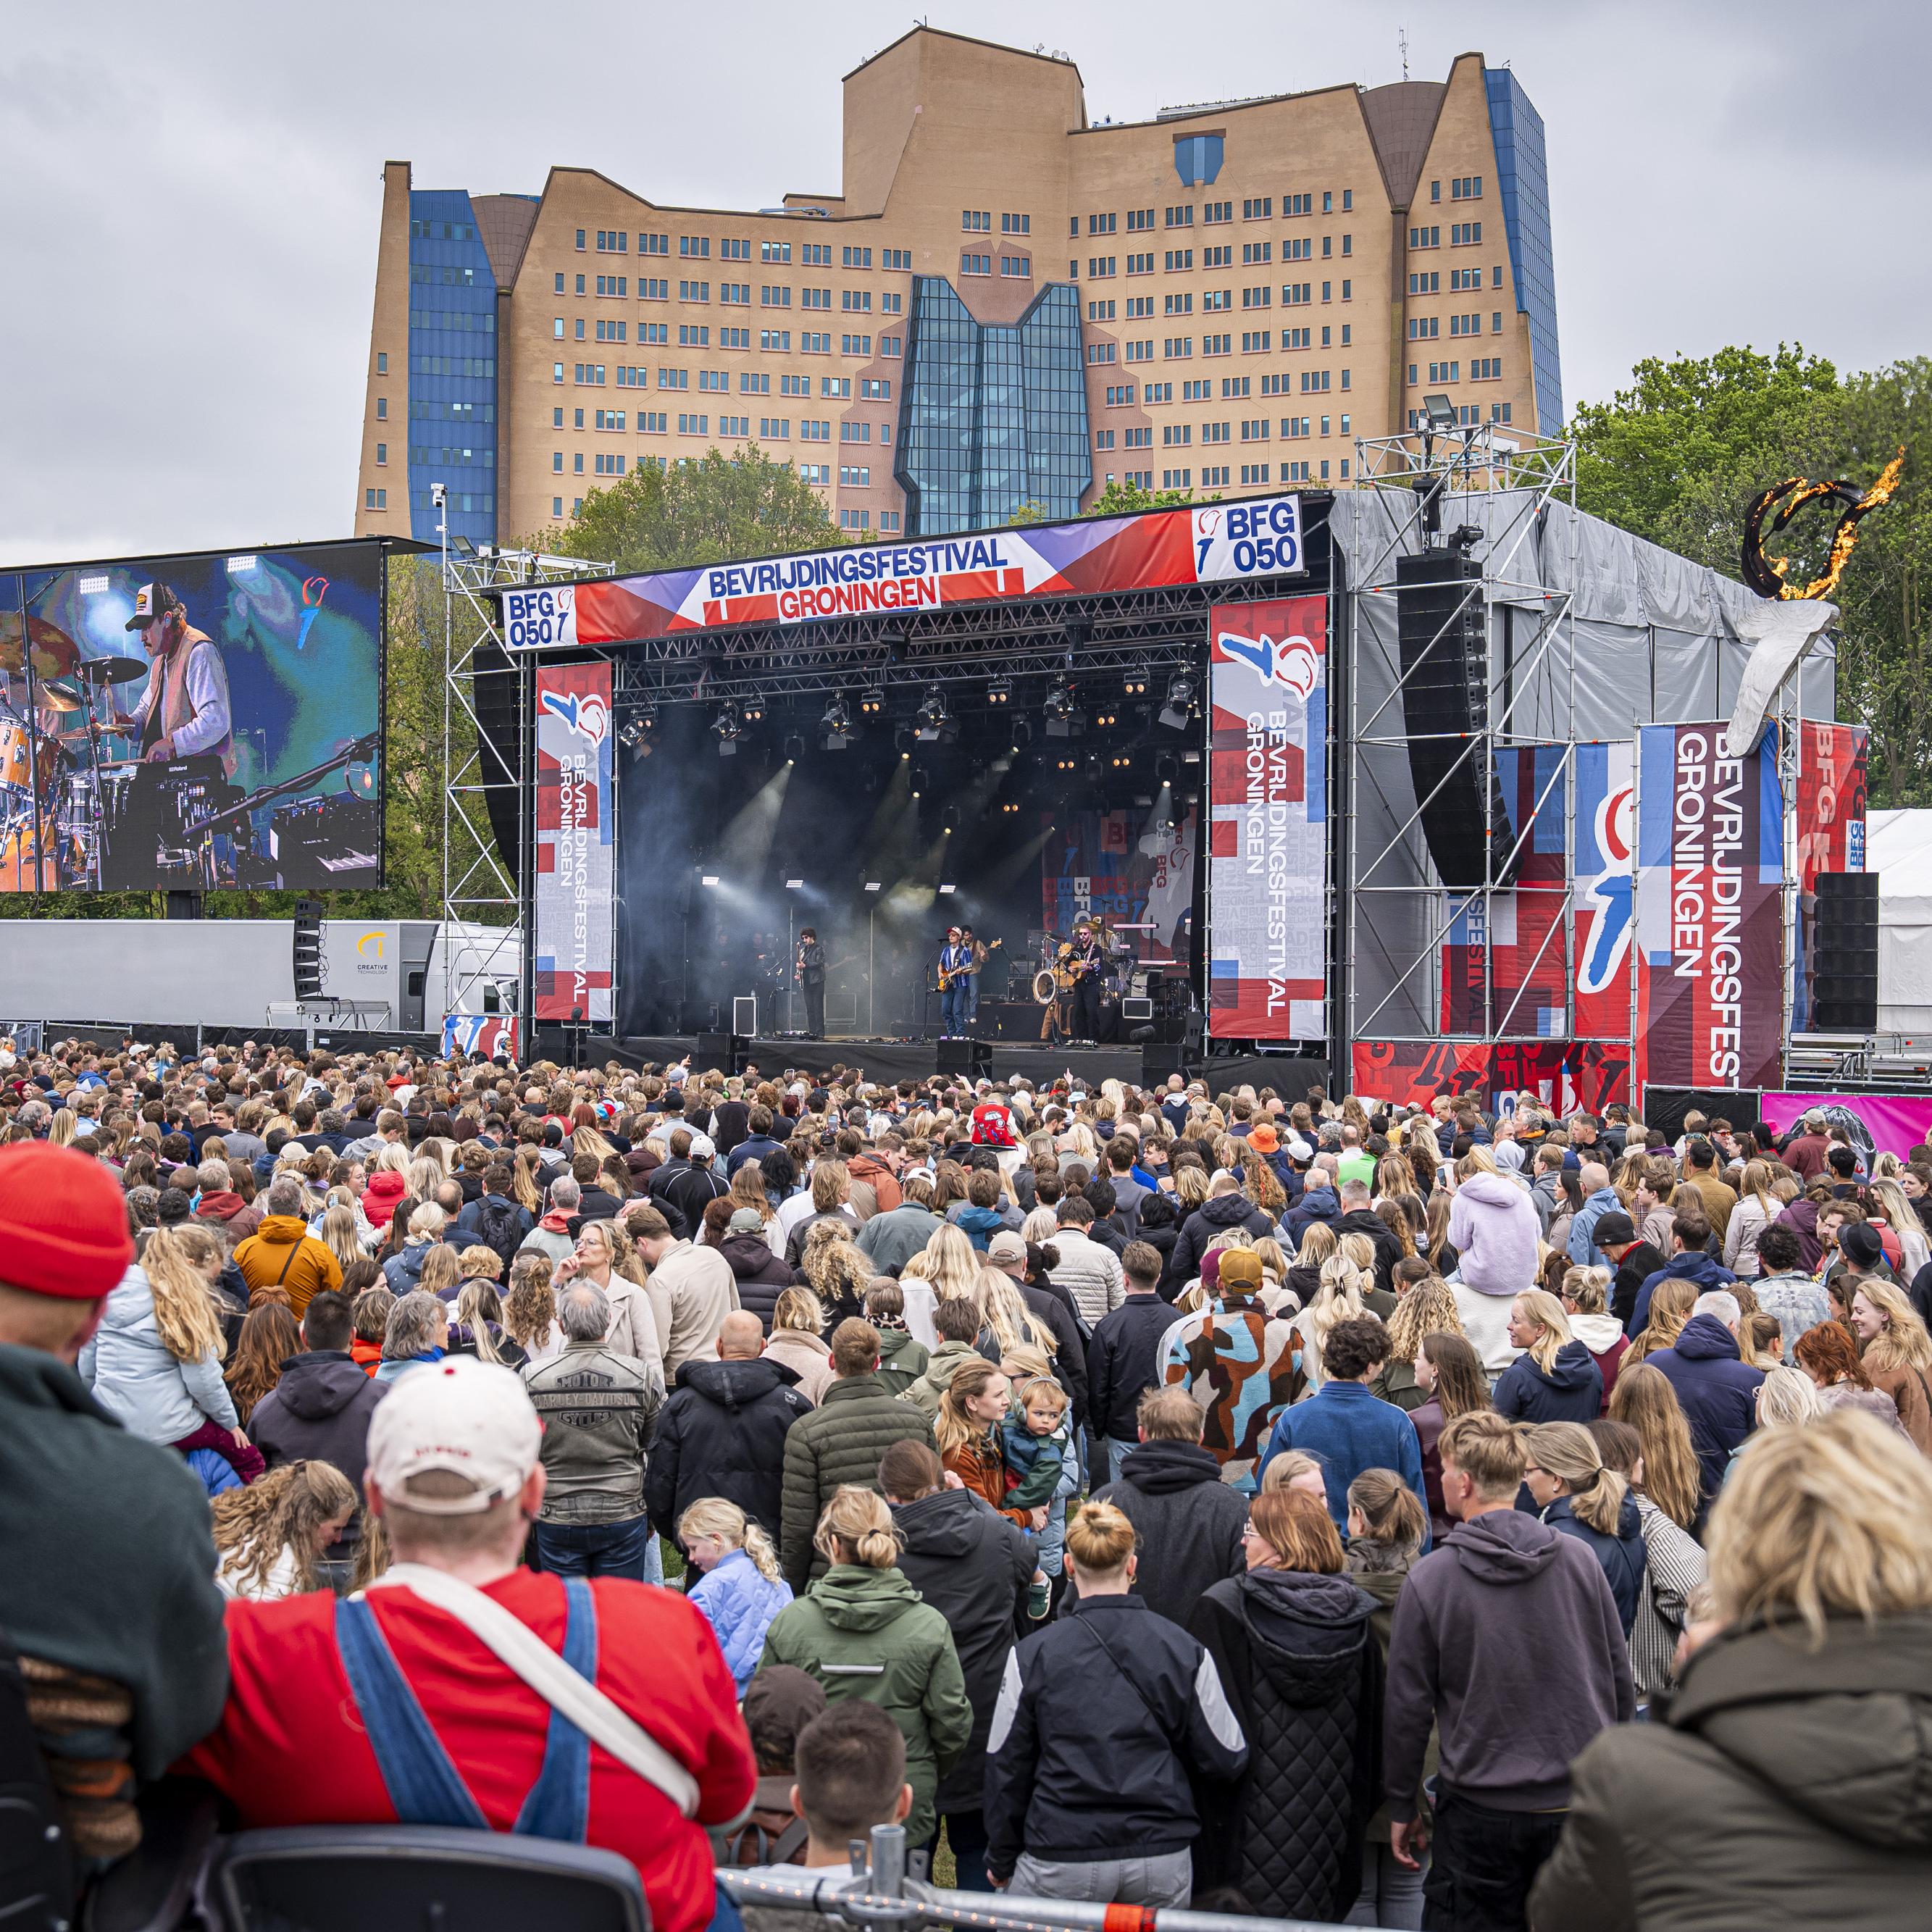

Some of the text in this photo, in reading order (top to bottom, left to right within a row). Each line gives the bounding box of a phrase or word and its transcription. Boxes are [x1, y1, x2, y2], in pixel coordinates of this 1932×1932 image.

[1226, 501, 1295, 541] BFG
[708, 538, 1008, 598] BEVRIJDINGSFESTIVAL
[1233, 535, 1297, 572] 050
[508, 590, 555, 621] BFG
[779, 575, 937, 619] GRONINGEN
[509, 619, 553, 647] 050
[1246, 711, 1265, 874] GRONINGEN
[1815, 723, 1836, 824] BFG
[559, 755, 573, 887] GRONINGEN
[1267, 711, 1287, 1017] BEVRIJDINGSFESTIVAL
[1674, 732, 1708, 977] GRONINGEN
[1850, 822, 1859, 866] BFG
[574, 754, 587, 1003] BEVRIJDINGSFESTIVAL
[1157, 855, 1167, 888] BFG
[561, 1373, 609, 1388] MOTOR
[562, 1412, 611, 1426] CYCLES
